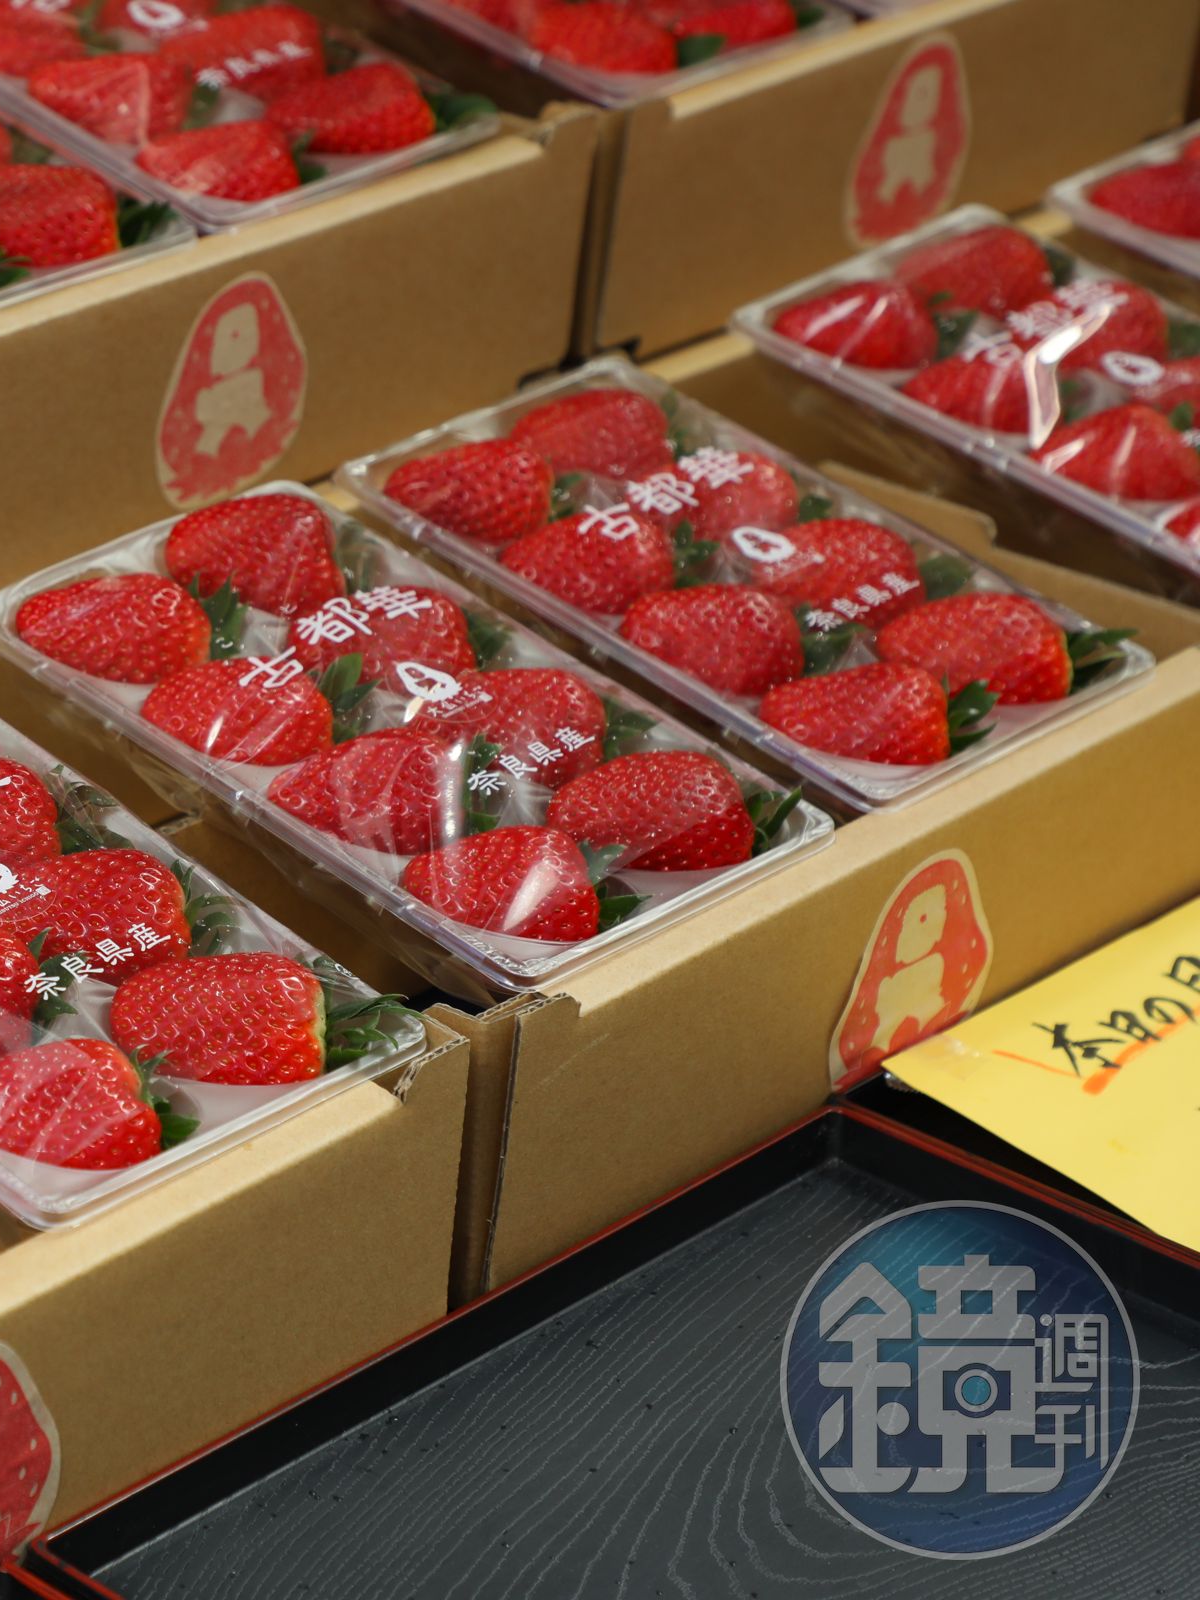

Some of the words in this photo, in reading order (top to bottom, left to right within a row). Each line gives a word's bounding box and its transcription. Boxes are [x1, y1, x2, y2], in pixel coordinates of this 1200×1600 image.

[577, 446, 755, 541] 古都華
[238, 585, 432, 689] 古都華
[467, 725, 595, 797] 奈良県産
[24, 921, 171, 1001] 奈良県産
